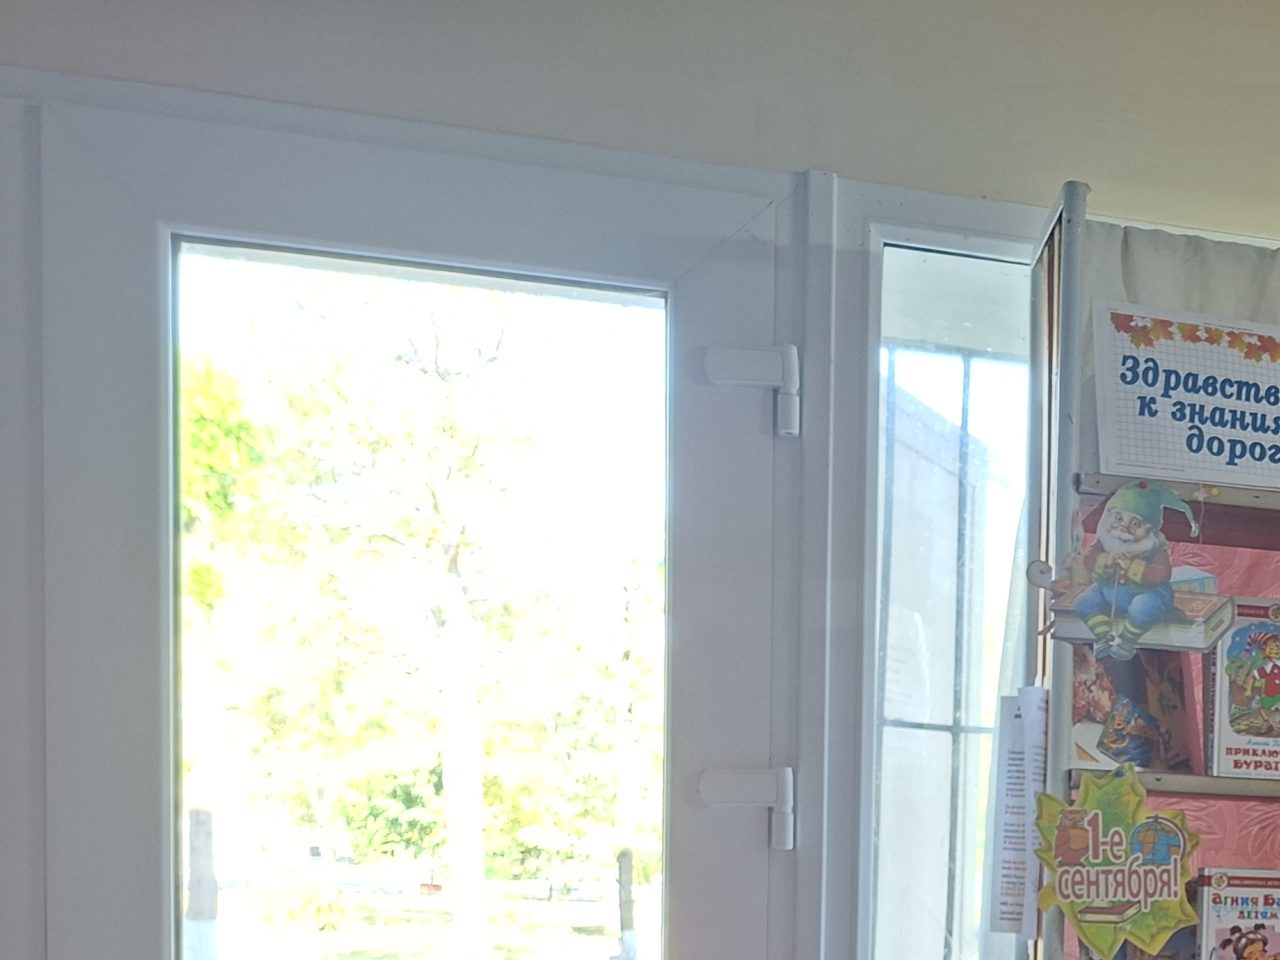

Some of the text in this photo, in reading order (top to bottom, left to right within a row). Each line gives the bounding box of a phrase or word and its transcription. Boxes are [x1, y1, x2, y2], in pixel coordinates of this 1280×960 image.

[1136, 395, 1158, 418] к
[1087, 811, 1125, 861] 1-е
[1057, 854, 1180, 910] сентября!
